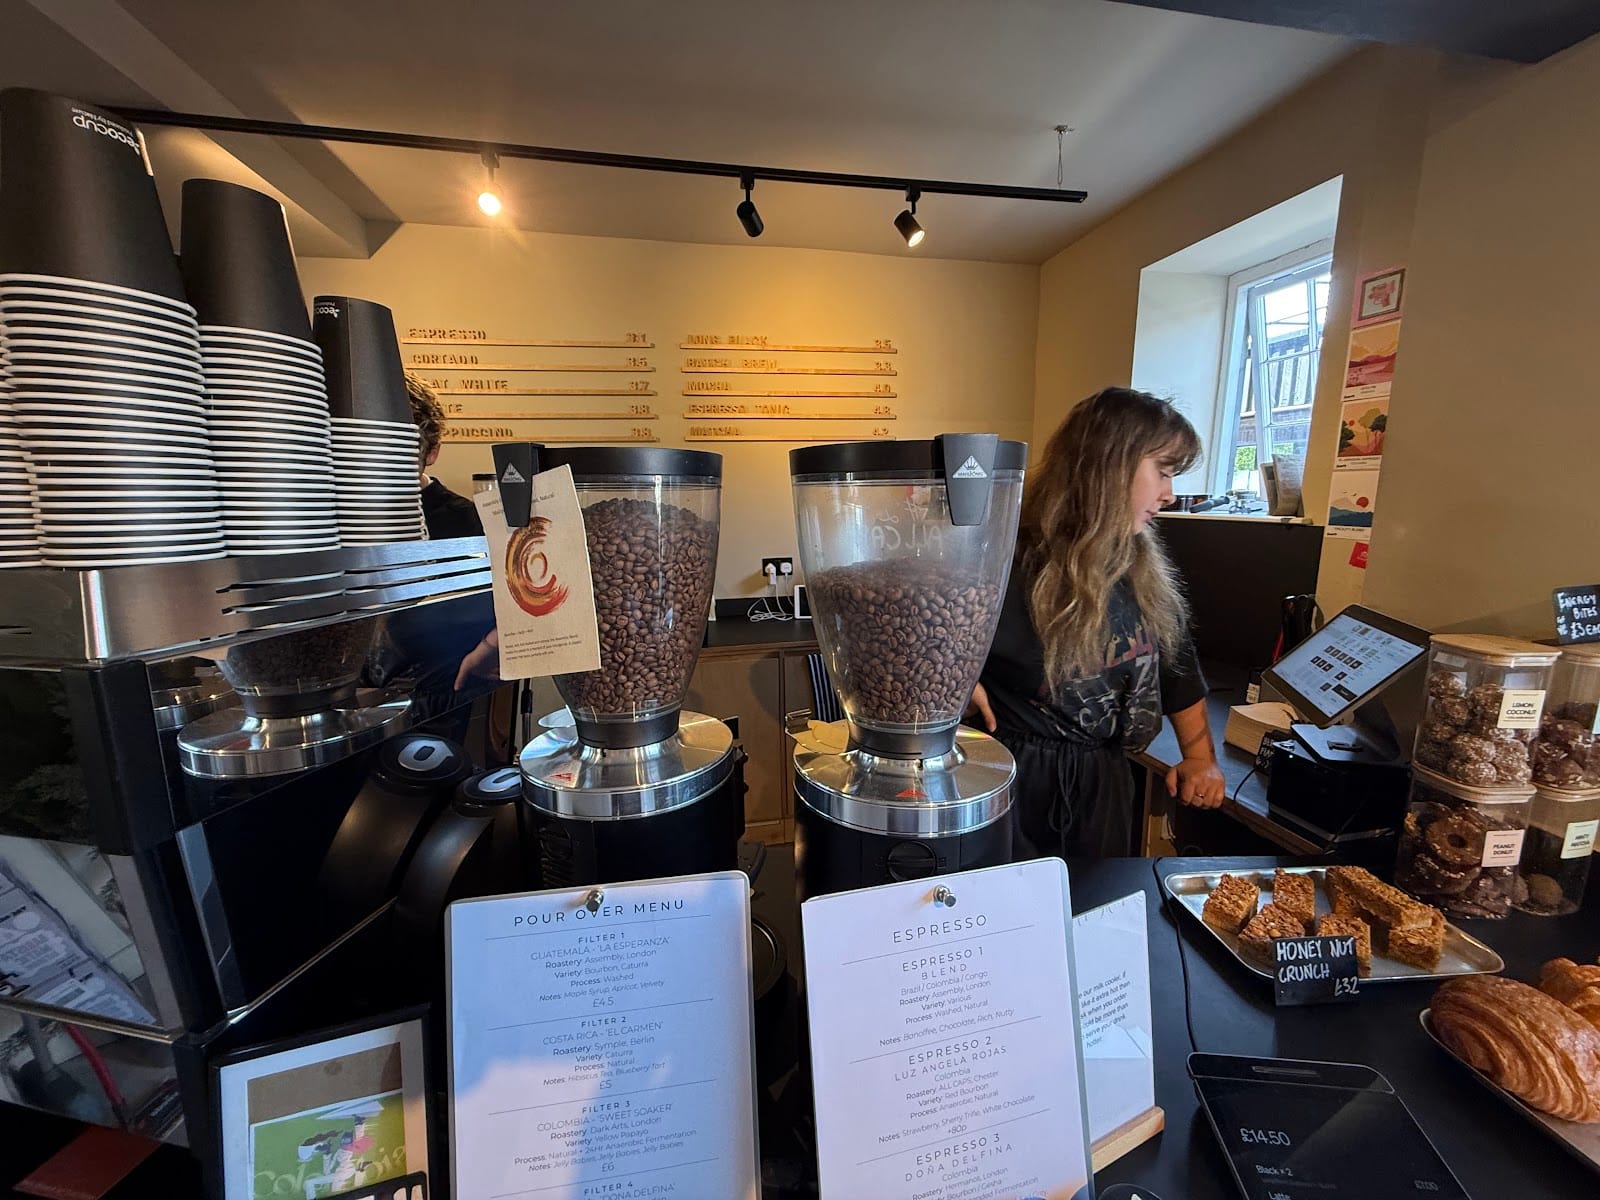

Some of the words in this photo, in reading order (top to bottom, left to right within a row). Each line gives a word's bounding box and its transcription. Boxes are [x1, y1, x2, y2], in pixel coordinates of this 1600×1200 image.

[72, 115, 136, 148] ecocup
[409, 328, 486, 340] ESPRESSO
[413, 354, 479, 364] CORTADO
[461, 380, 509, 389] WHITE
[689, 404, 746, 413] ESPRESSO
[755, 405, 790, 414] TONIC
[514, 912, 565, 927] POUR
[634, 900, 684, 913] MENU
[893, 914, 987, 943] ESPRESSO
[578, 934, 616, 944] FILTER
[531, 946, 590, 961] GUATEMALA
[626, 949, 656, 959] London
[1276, 940, 1322, 961] HONEY
[1329, 937, 1354, 958] NUT
[621, 960, 648, 970] Caturra
[902, 949, 972, 972] ESPRESSO
[978, 947, 983, 955] 1
[604, 973, 634, 982] Washed
[921, 963, 968, 980] BLEND
[1278, 963, 1330, 983] CRUNCH
[926, 976, 960, 990] Colombia
[965, 971, 988, 982] Congo
[965, 980, 991, 991] London
[947, 994, 972, 1005] Various
[964, 999, 988, 1011] Natural
[581, 1017, 616, 1028] FILTER
[543, 1034, 574, 1045] COSTA
[576, 1030, 598, 1040] RICA
[630, 1036, 655, 1046] Berlin
[605, 1049, 633, 1059] Caturra
[908, 1039, 979, 1065] ESPRESSO
[985, 1036, 992, 1046] 2
[607, 1058, 635, 1067] Natural
[894, 1069, 916, 1082] LUZ
[922, 1056, 967, 1074] ANGELA
[972, 1046, 1007, 1061] ROJAS
[934, 1067, 971, 1082] Colombia
[939, 1082, 952, 1091] ALL
[974, 1070, 999, 1083] Chester
[944, 1091, 959, 1099] Red
[960, 1083, 989, 1096] Bourbon
[974, 1090, 999, 1101] Natural
[582, 1102, 620, 1114] FILTER
[982, 1104, 1002, 1115] White
[537, 1118, 590, 1132] COLOMBIA
[590, 1124, 610, 1134] Dark
[630, 1116, 662, 1128] London
[1240, 1127, 1291, 1146] £14.50
[549, 1149, 578, 1160] Natural
[916, 1137, 987, 1166] ESPRESSO
[993, 1133, 1000, 1143] 3
[952, 1143, 1013, 1168] DELFINA
[942, 1166, 978, 1182] Colombia
[982, 1167, 1008, 1180] London
[1255, 1164, 1280, 1176] Black
[584, 1183, 622, 1196] FILTER
